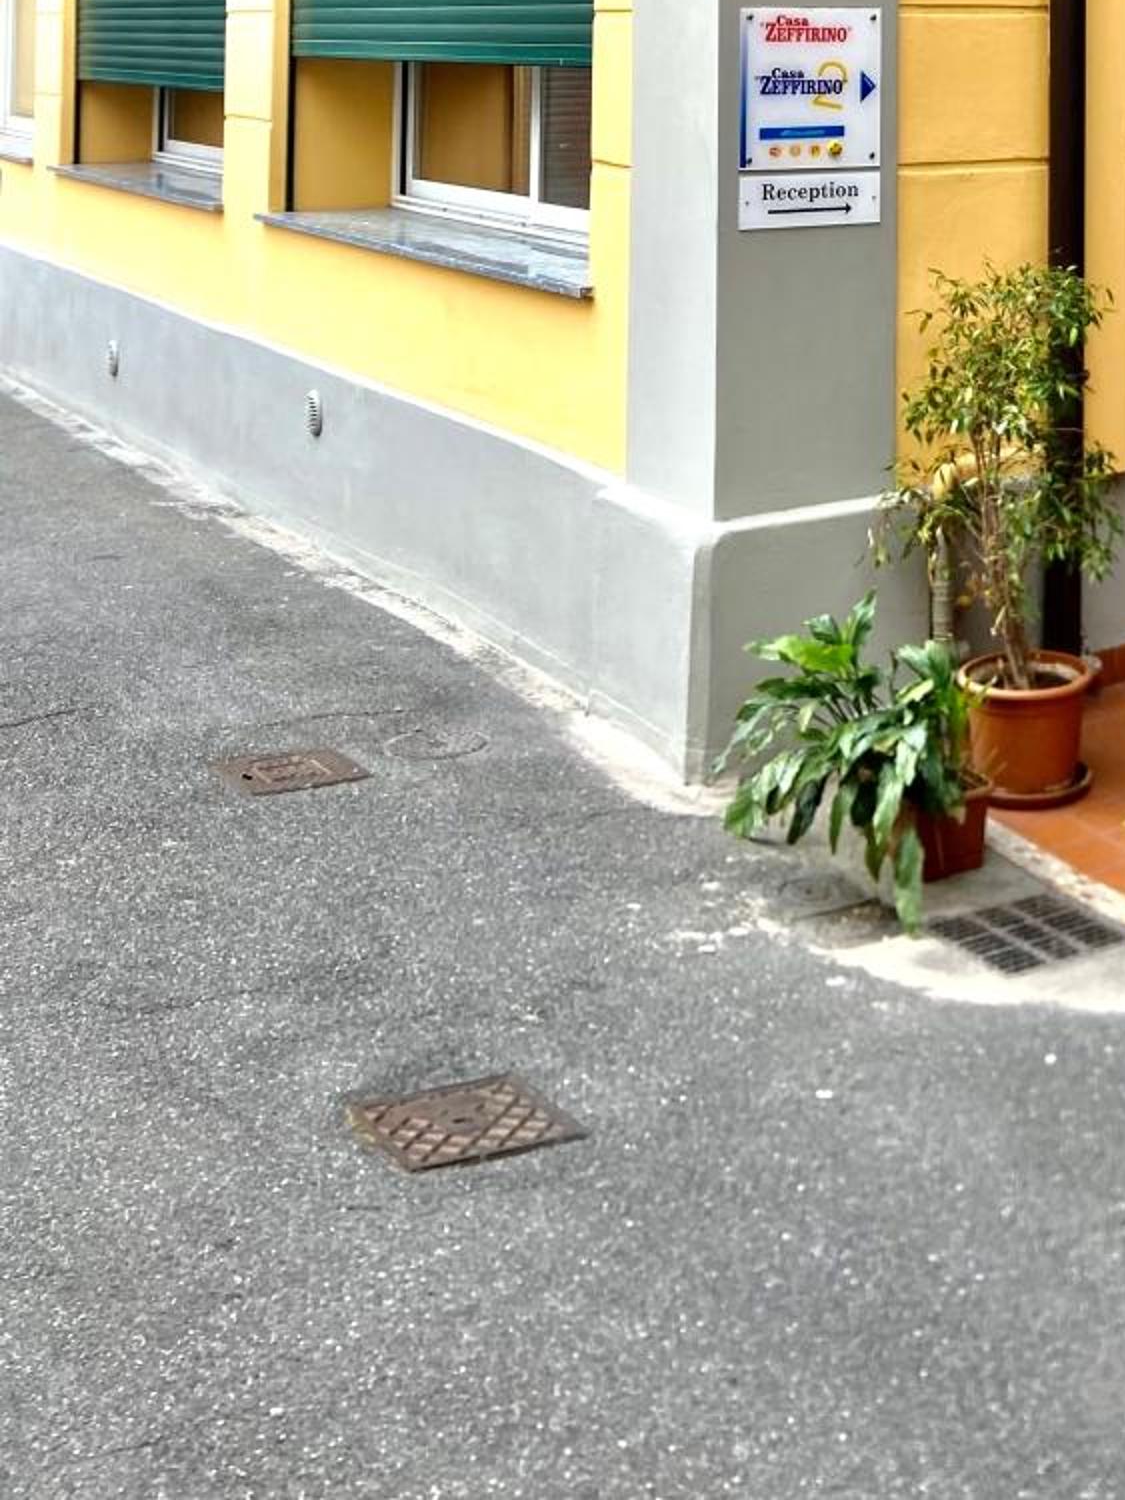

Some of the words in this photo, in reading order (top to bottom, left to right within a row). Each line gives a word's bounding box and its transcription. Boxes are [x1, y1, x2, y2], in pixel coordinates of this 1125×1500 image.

[776, 15, 809, 27] Casa
[771, 67, 805, 79] Casa
[761, 182, 859, 202] Reception
